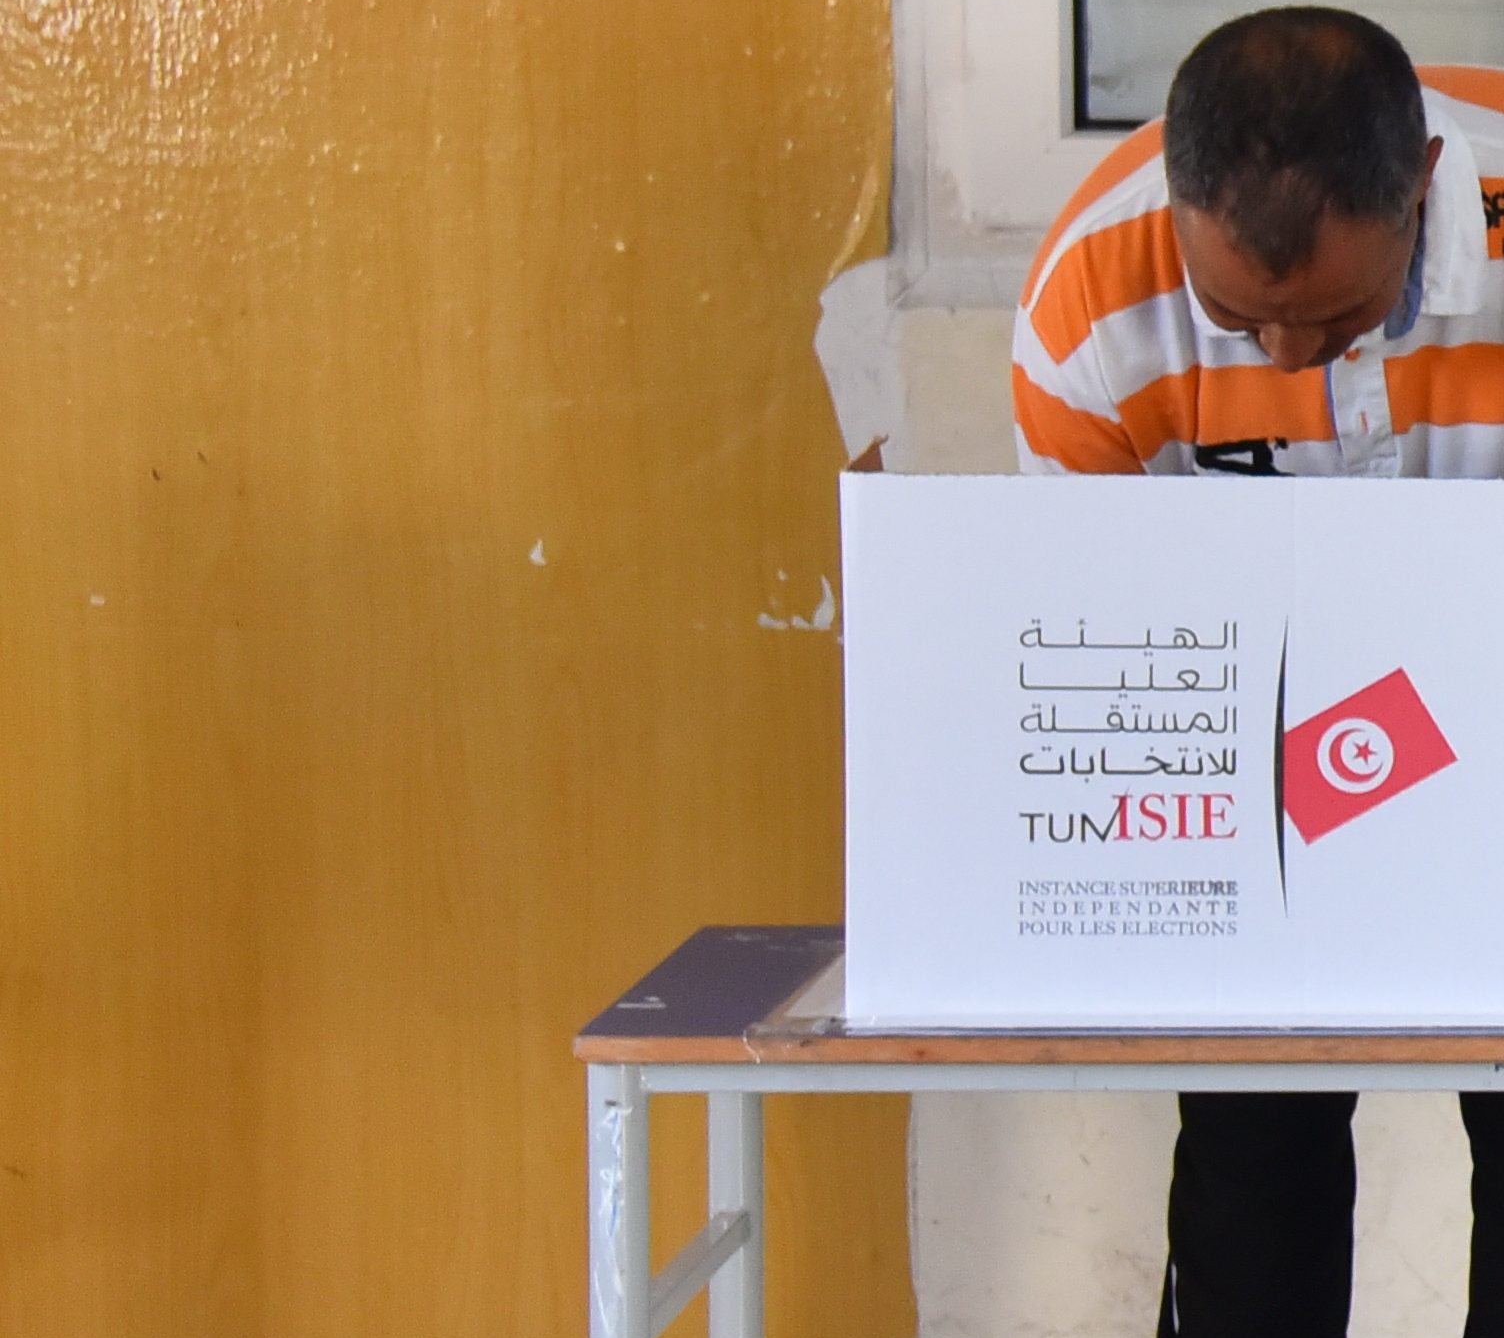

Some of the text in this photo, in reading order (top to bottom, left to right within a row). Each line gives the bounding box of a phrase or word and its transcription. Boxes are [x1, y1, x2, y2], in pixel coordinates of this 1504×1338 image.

[1019, 619, 1237, 657] الهيئة
[1019, 662, 1237, 699] العليا
[1019, 703, 1237, 735] المستقلة
[1019, 745, 1237, 783] للانتخابات
[1018, 880, 1238, 897] INSTANCE SUPERIEURE
[1018, 900, 1238, 916] INDEPENDANTE
[1018, 920, 1238, 937] POUR LES ELECTIONS
